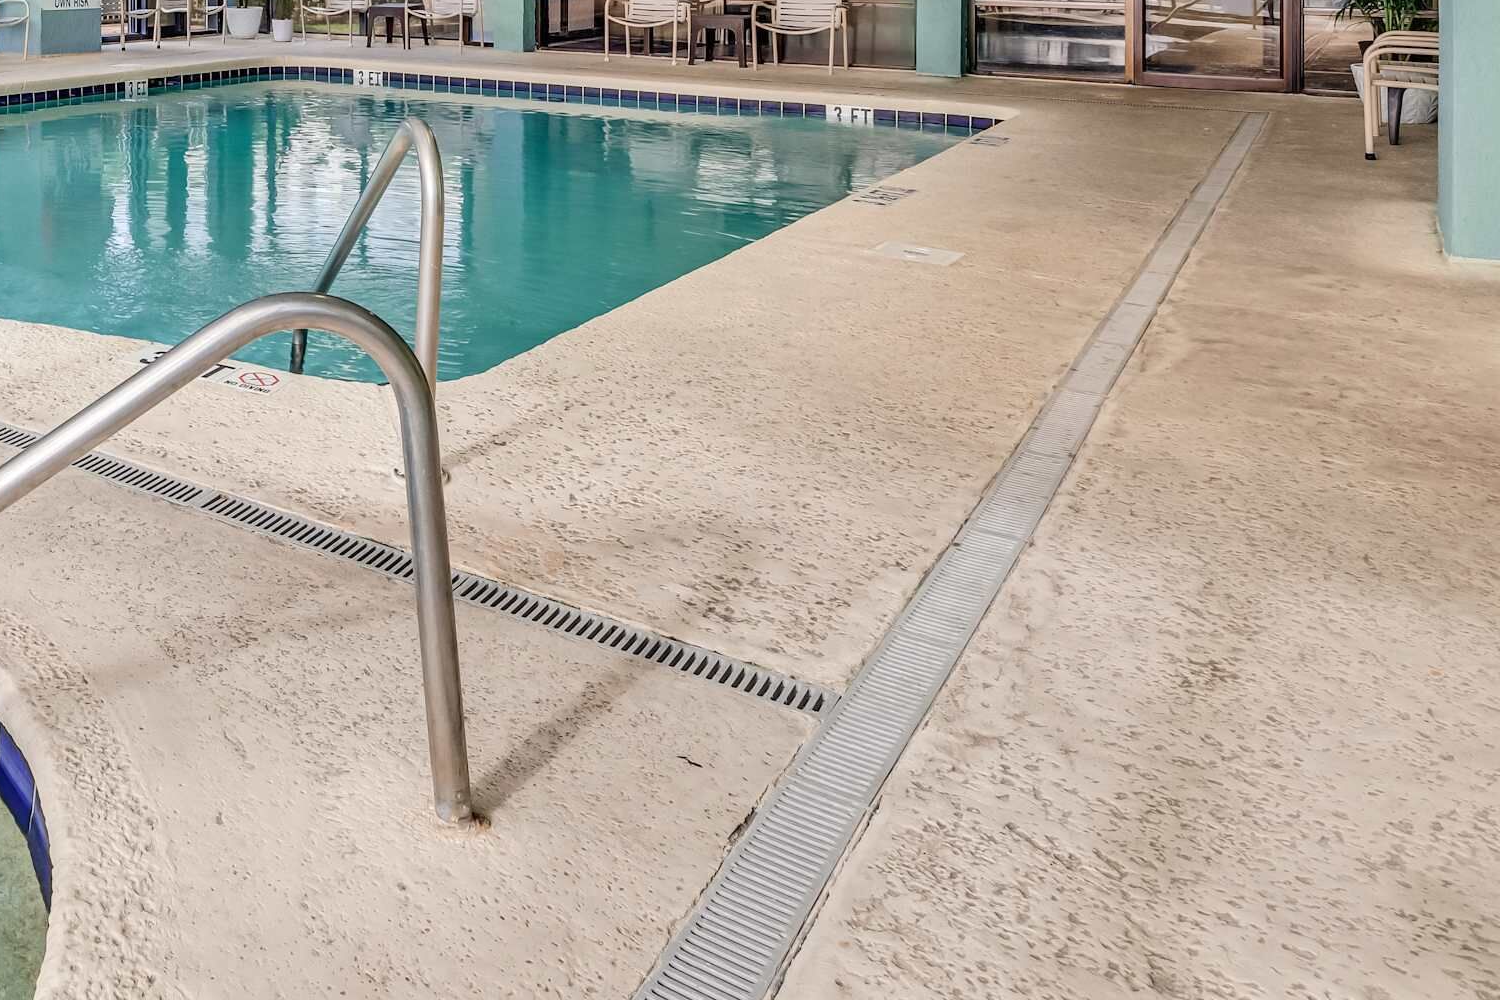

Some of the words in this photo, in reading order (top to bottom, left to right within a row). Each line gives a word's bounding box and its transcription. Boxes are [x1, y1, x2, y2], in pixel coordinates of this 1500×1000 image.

[358, 71, 364, 85] 3
[851, 108, 871, 122] FT
[239, 384, 271, 393] DIVING
